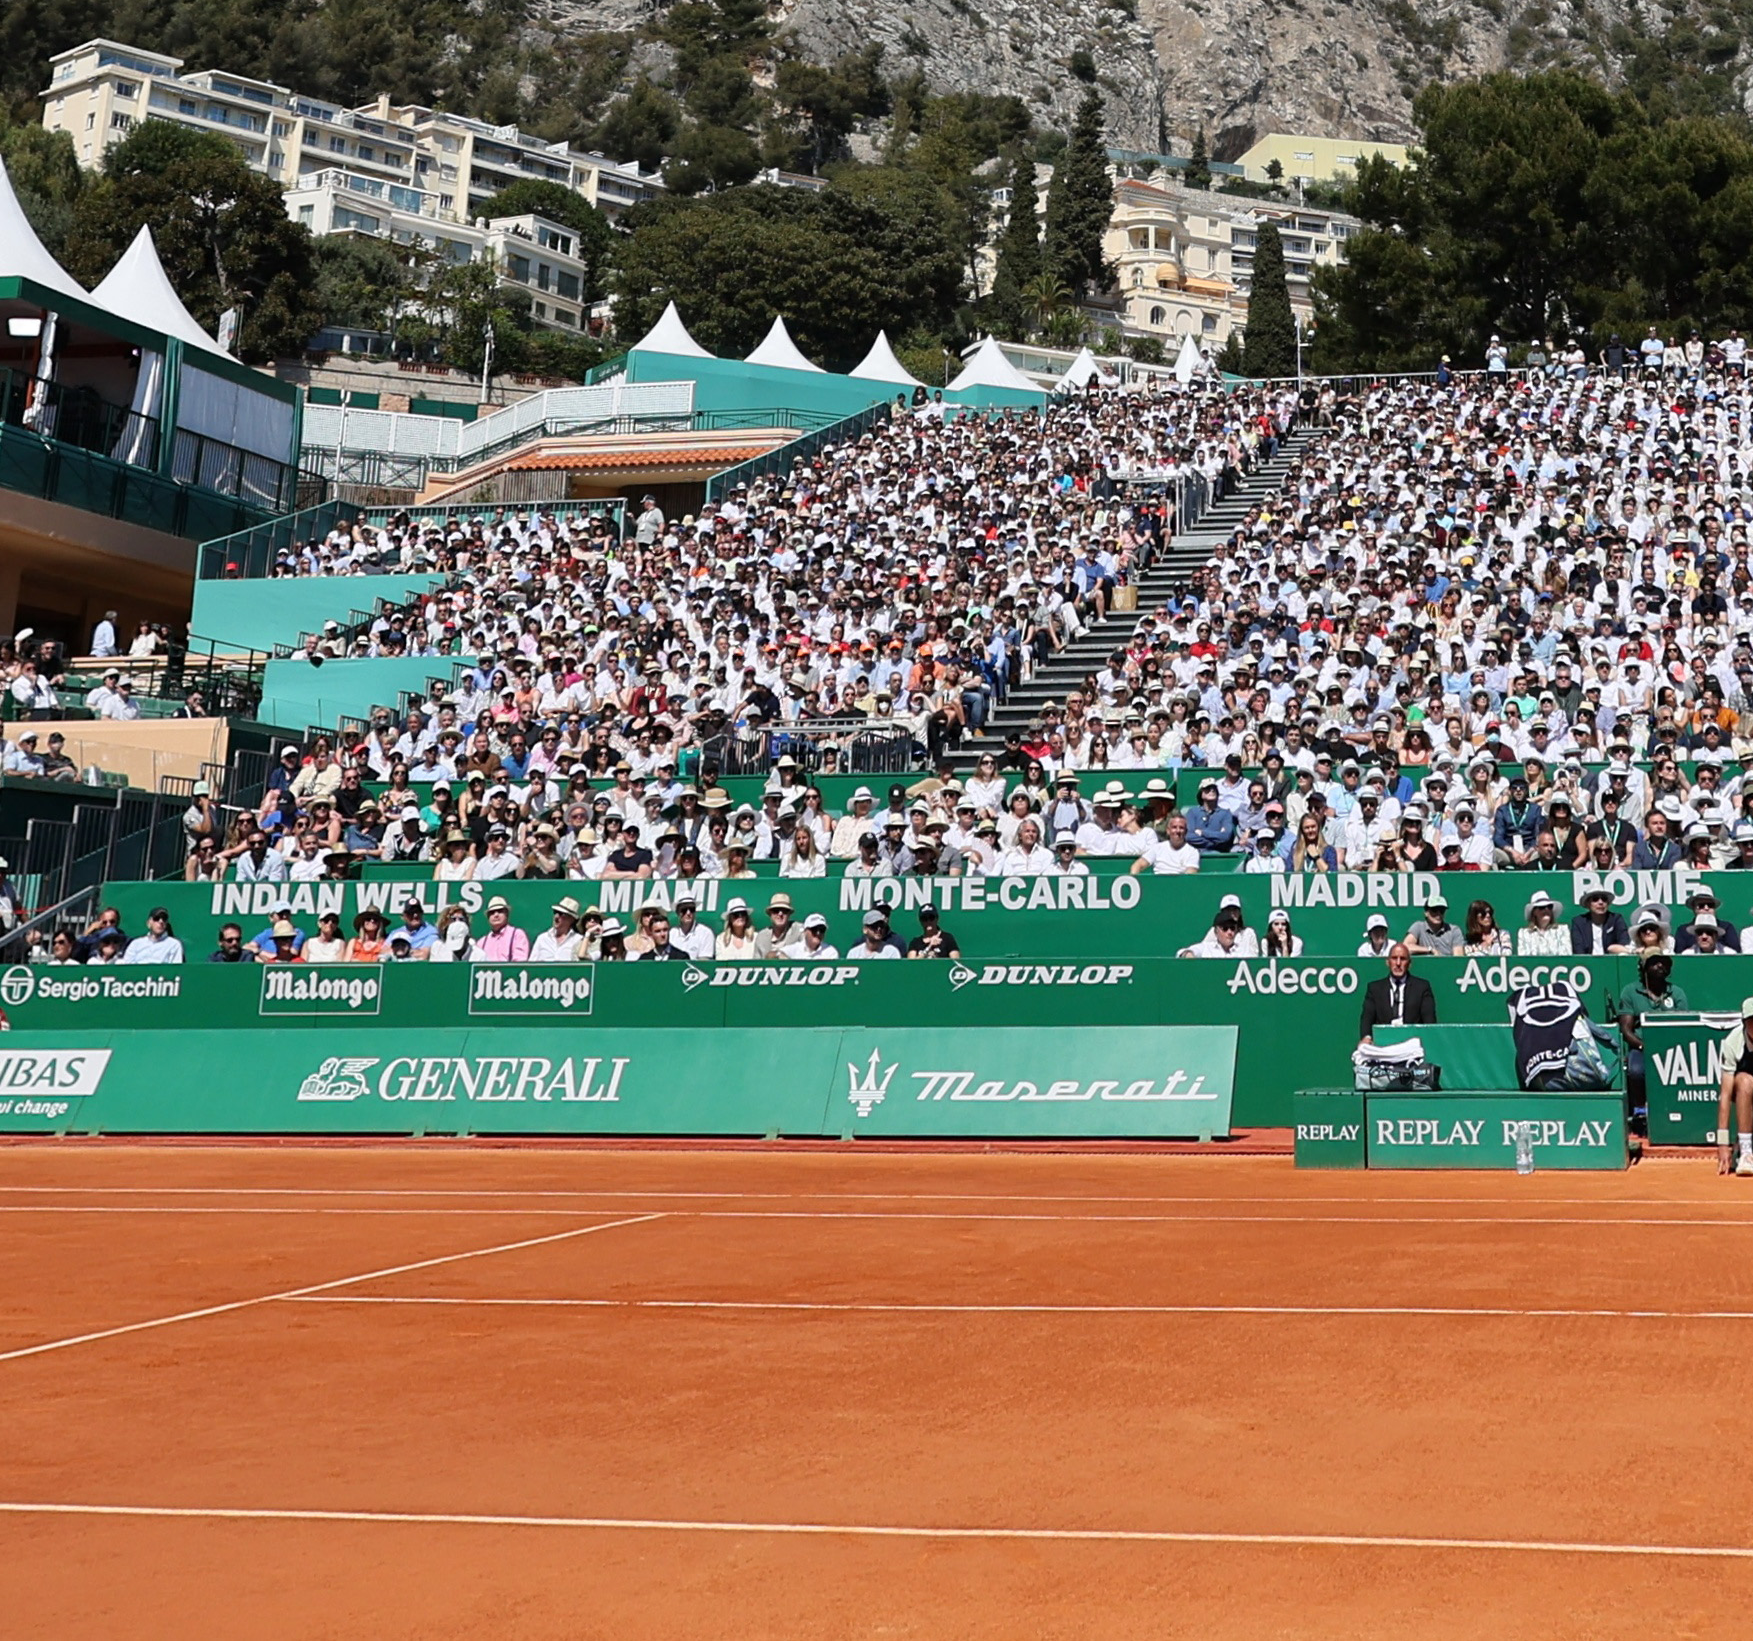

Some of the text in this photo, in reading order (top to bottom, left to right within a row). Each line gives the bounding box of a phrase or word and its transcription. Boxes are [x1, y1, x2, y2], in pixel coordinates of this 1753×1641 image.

[211, 881, 484, 915] INDIAN WELLS
[599, 880, 719, 913] MIAMI
[840, 875, 1141, 911] MONTE-CARLO
[1270, 873, 1442, 908] MADRID
[37, 976, 181, 1002] Sergio Tacchini
[265, 970, 378, 1008] Malongo
[474, 969, 590, 1008] Malongo
[709, 966, 860, 986] DUNLOP
[978, 964, 1133, 985] DUNLOP
[1226, 959, 1359, 995] Adecco
[1456, 958, 1592, 994] Adecco
[378, 1057, 630, 1101] GENERALI
[911, 1070, 1219, 1101] Maserati
[14, 1100, 69, 1118] change
[1677, 1090, 1721, 1102] MINER
[1297, 1124, 1360, 1142] REPLAY
[1376, 1119, 1613, 1146] REPLAY REPLAY
